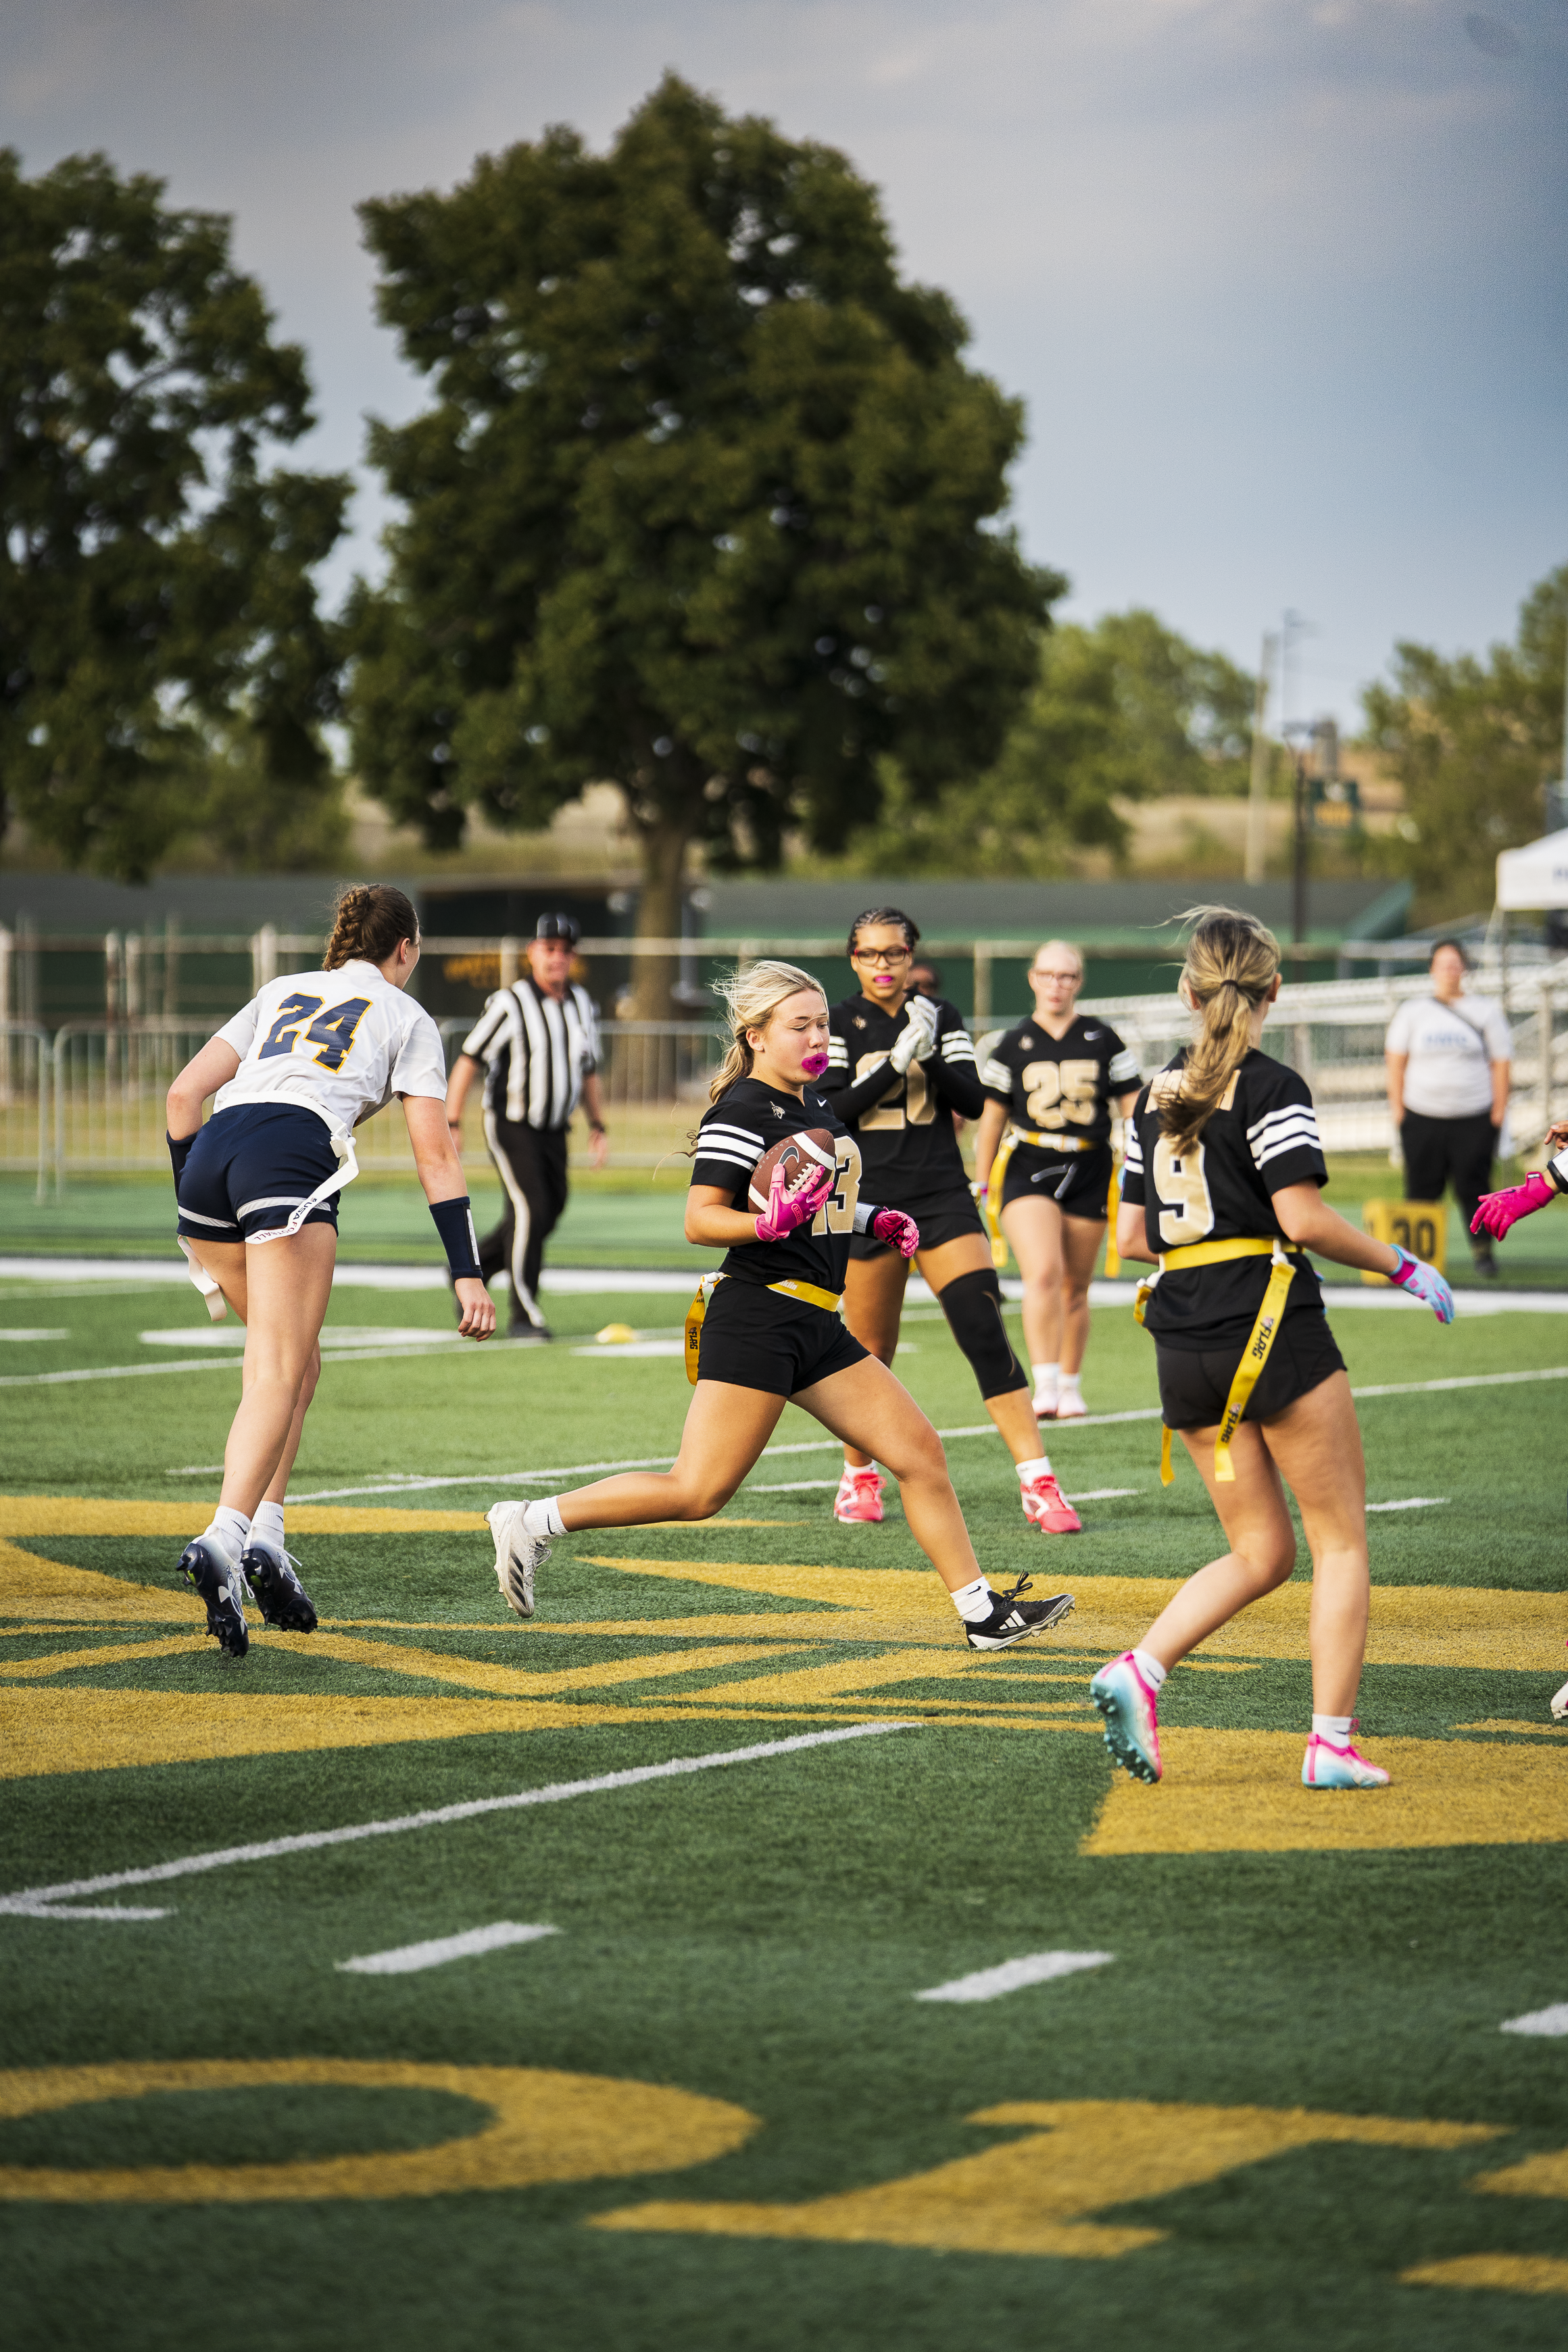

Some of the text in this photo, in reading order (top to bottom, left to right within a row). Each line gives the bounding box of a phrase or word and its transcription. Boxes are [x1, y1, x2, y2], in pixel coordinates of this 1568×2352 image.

[258, 991, 373, 1075] 24
[1022, 1059, 1100, 1129] 25
[1152, 1132, 1215, 1246] 9
[253, 1202, 312, 1240] USA FOOTBALL
[688, 1331, 698, 1350] FLAG
[1251, 1321, 1272, 1361] FLAG
[1220, 1408, 1239, 1444] FLAG
